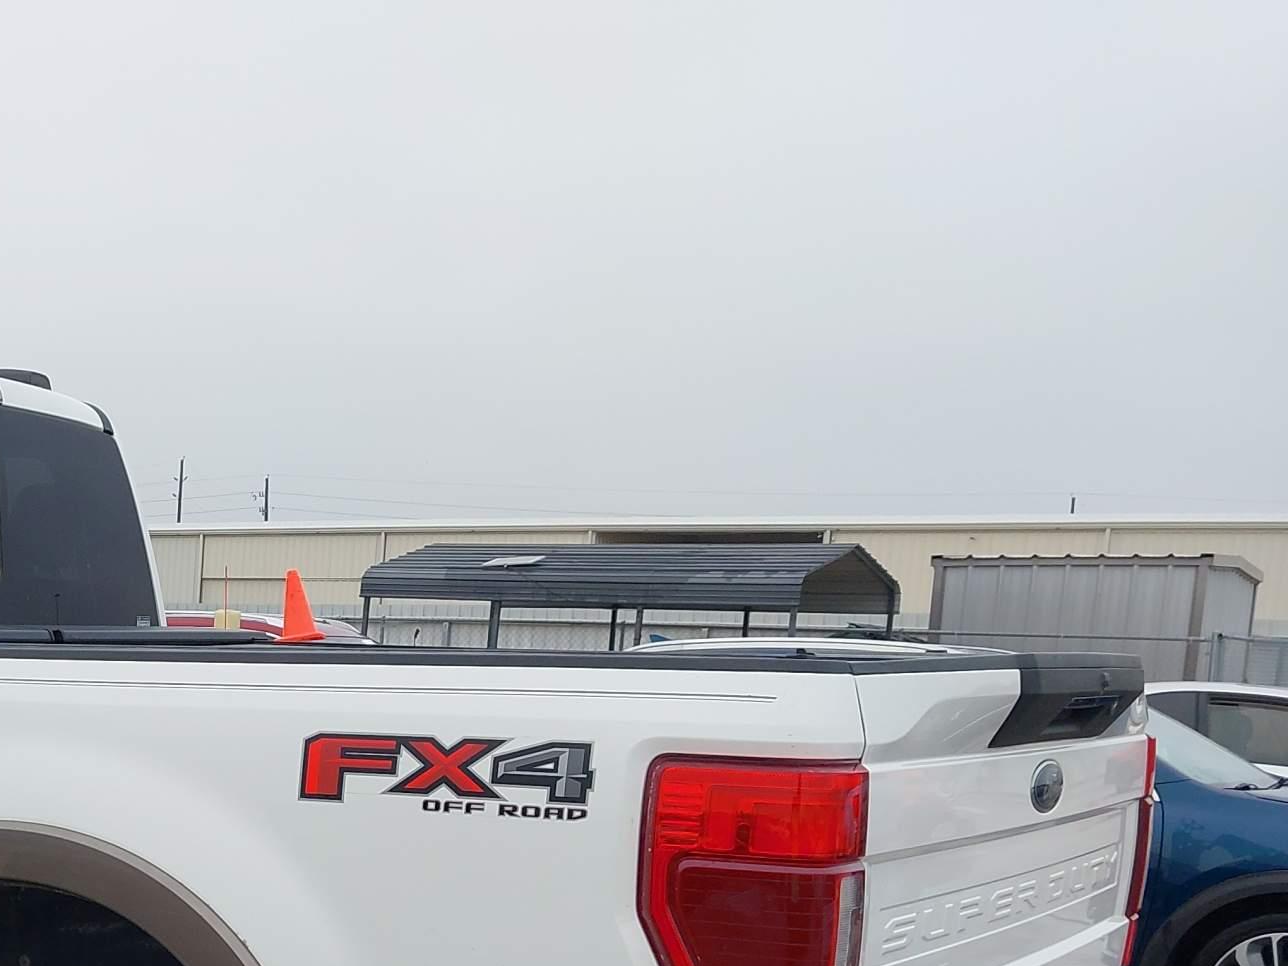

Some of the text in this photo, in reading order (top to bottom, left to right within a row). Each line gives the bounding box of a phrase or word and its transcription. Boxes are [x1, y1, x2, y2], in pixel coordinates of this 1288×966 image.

[298, 731, 596, 804] FX4
[421, 799, 588, 821] OFF ROAD
[880, 879, 1039, 957] SUPER
